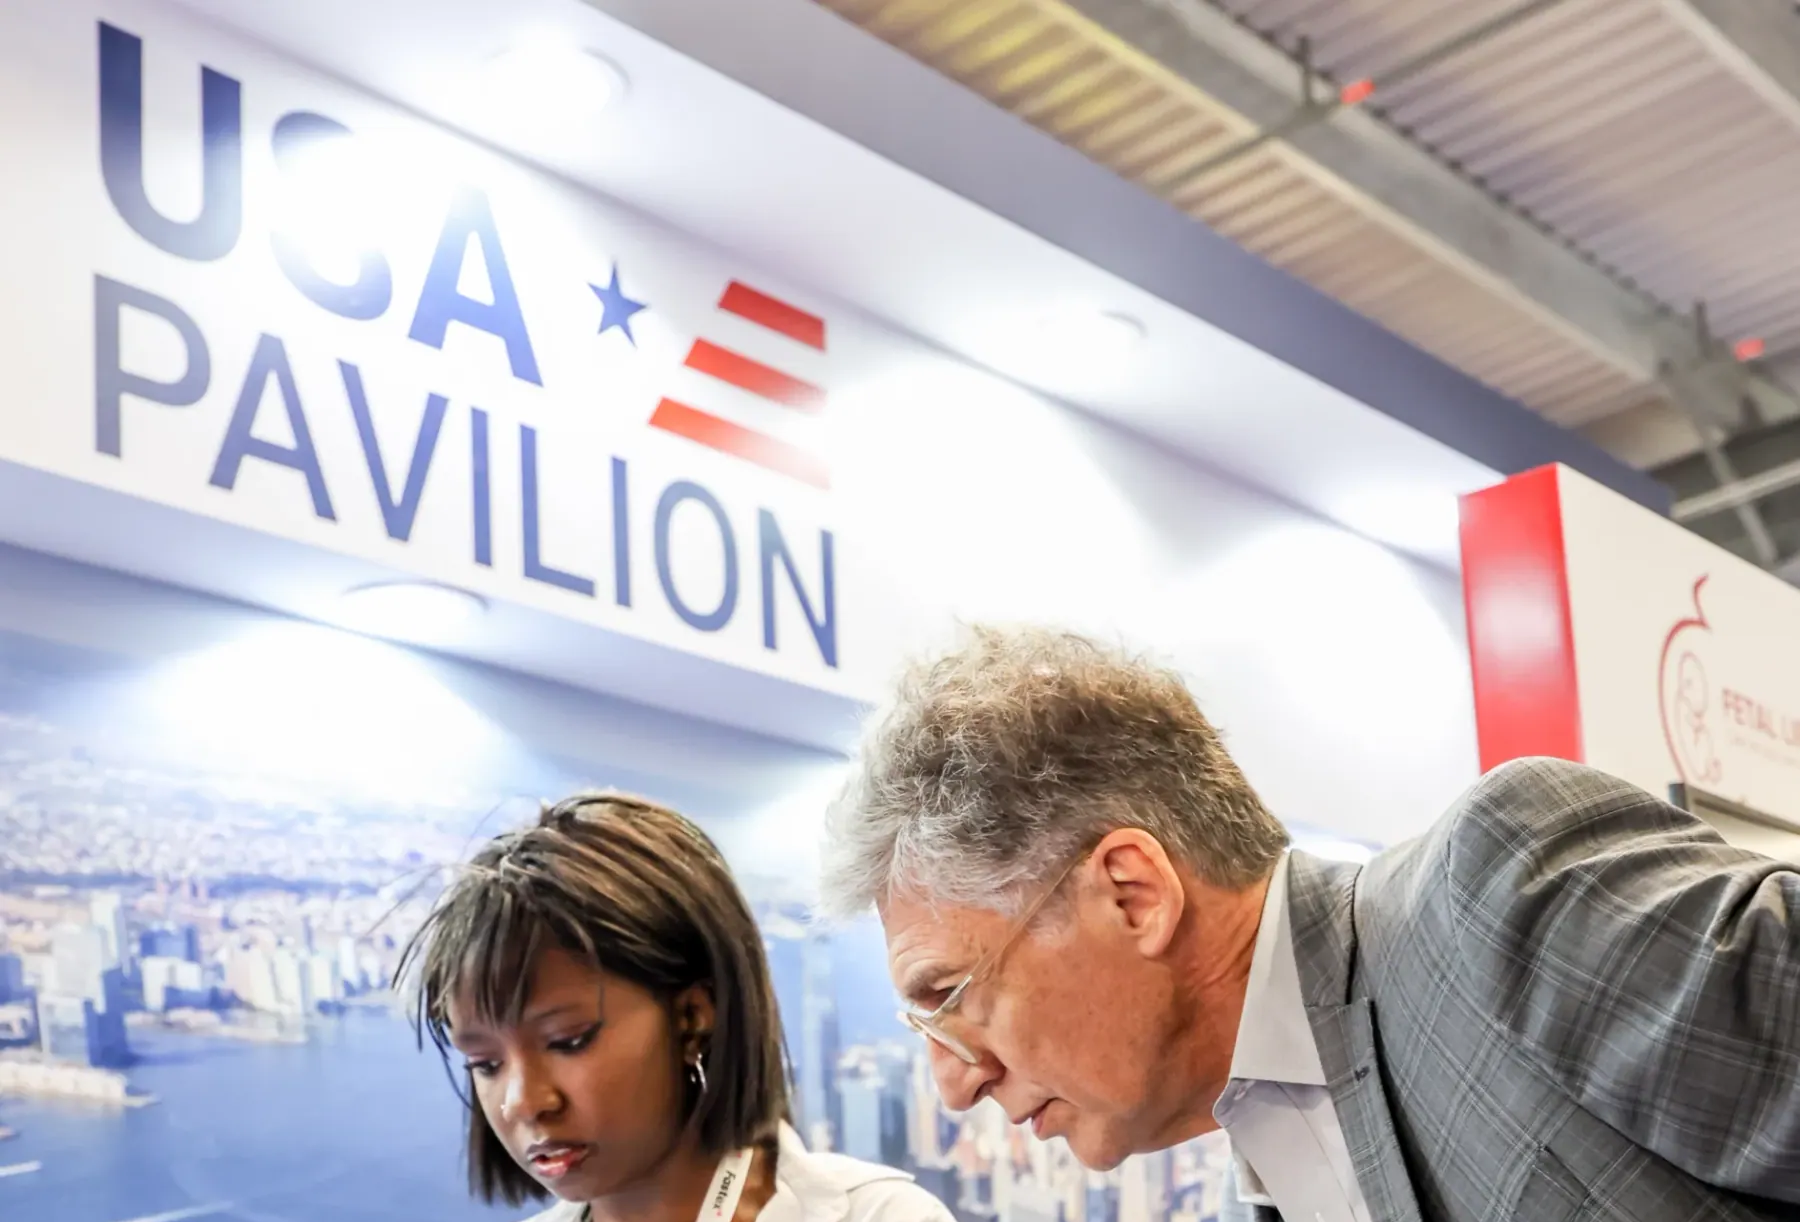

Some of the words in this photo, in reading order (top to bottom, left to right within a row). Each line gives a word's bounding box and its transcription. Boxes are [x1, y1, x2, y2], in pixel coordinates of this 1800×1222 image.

[97, 20, 544, 388] USA
[93, 272, 839, 670] PAVILION
[712, 1169, 737, 1210] Fastex
